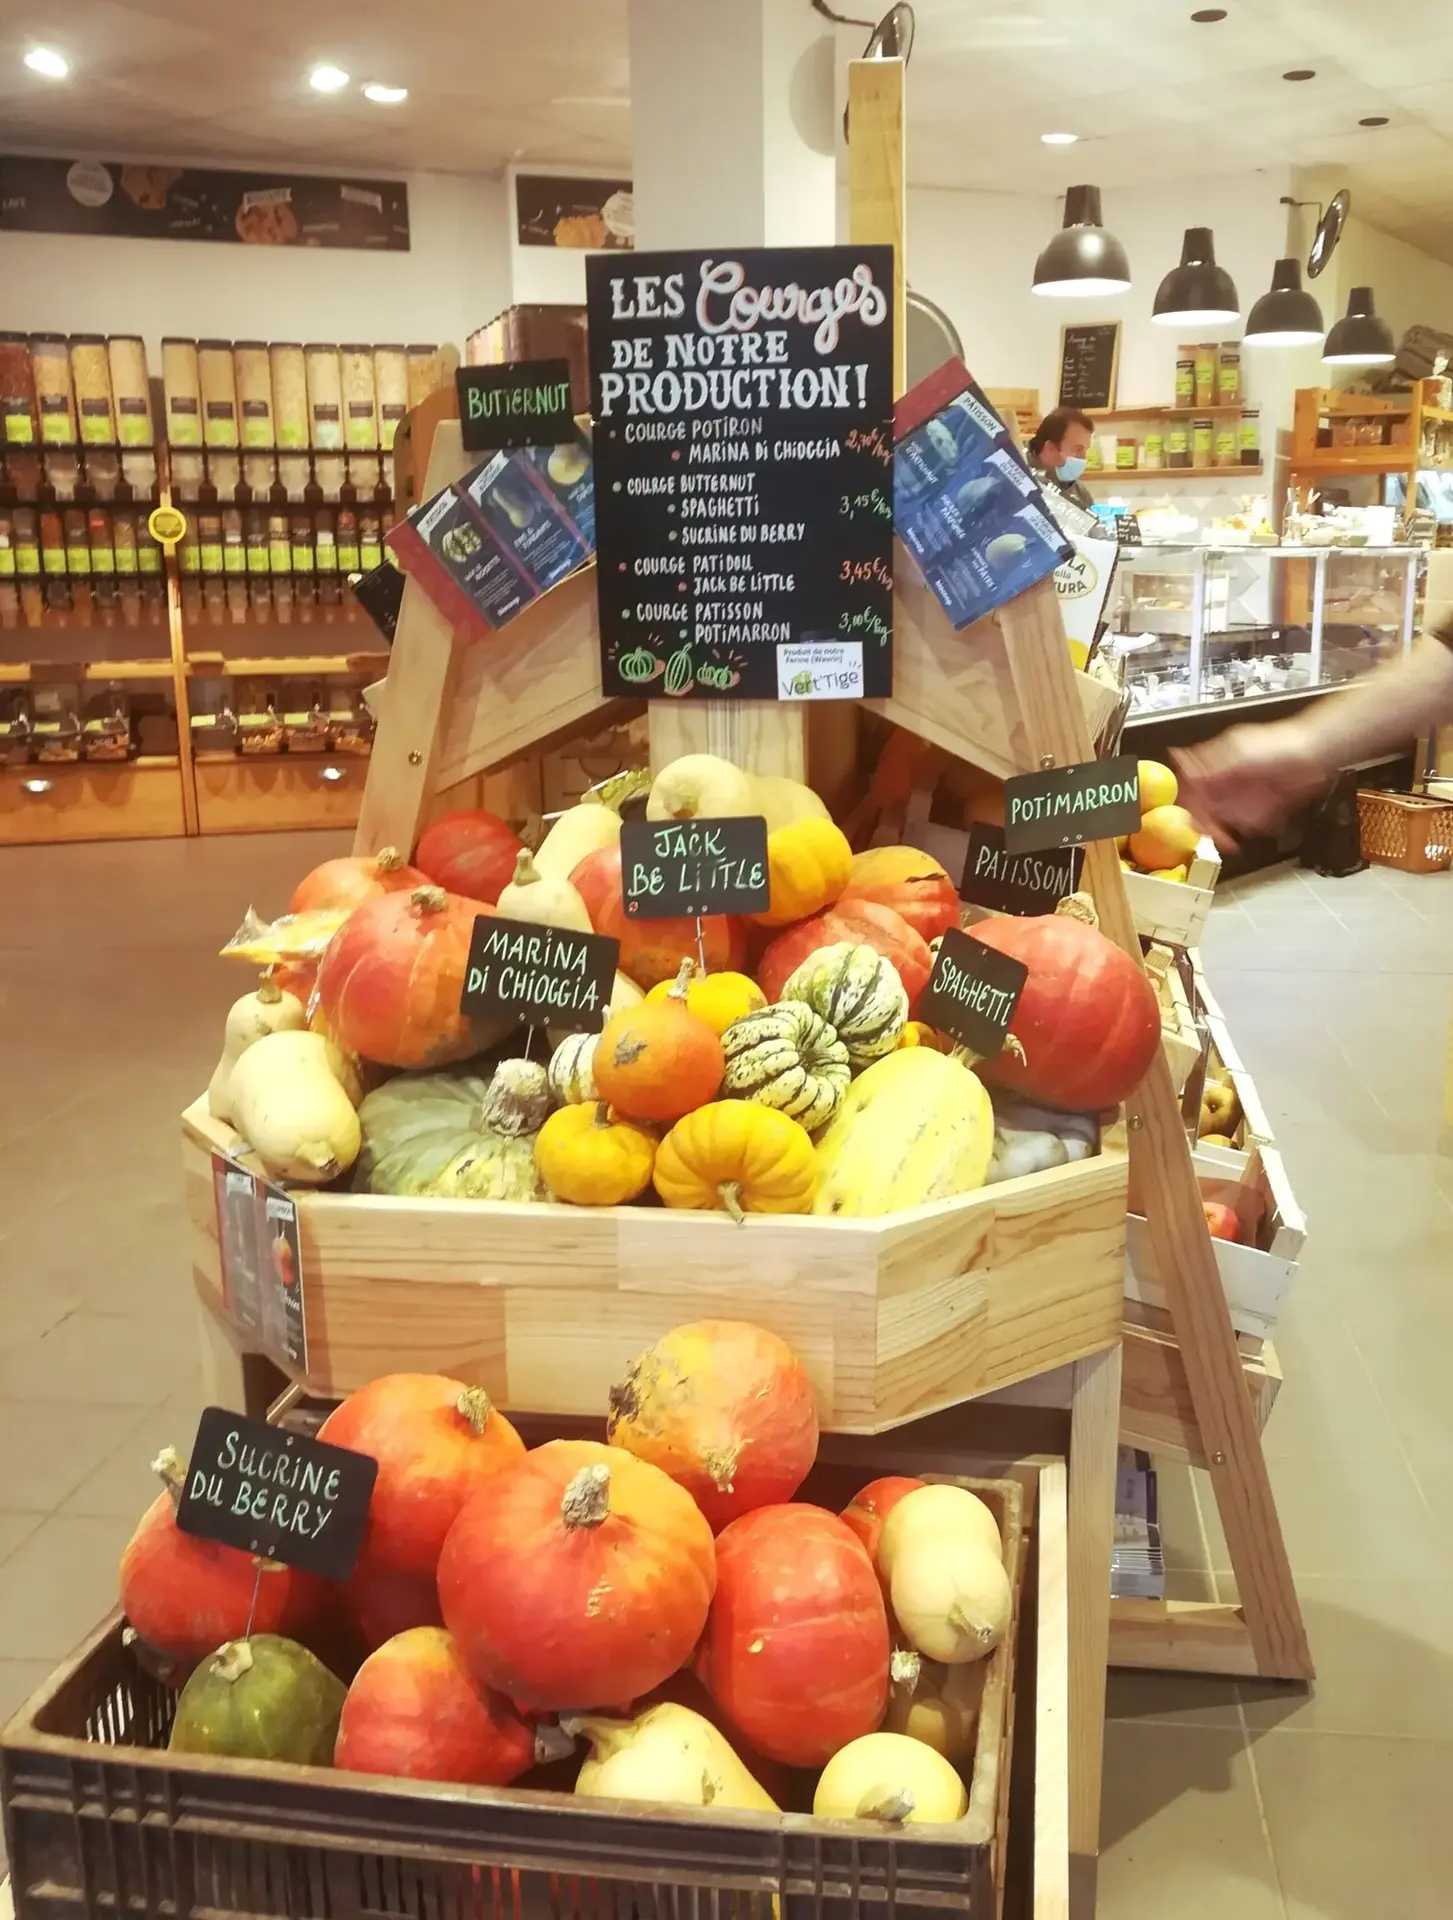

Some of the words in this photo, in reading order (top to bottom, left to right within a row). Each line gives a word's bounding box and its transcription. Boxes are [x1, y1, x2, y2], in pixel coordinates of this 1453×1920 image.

[610, 273, 685, 320] LES
[696, 259, 887, 355] Courges
[611, 337, 653, 369] DE
[665, 330, 788, 368] NOTRE
[468, 382, 569, 419] BUTTERNUT
[600, 364, 869, 417] PRODUCTION!
[625, 421, 686, 443] COURGE
[627, 476, 675, 495] COURGE
[680, 472, 756, 494] BUTTERNUT
[740, 525, 757, 543] DU
[760, 522, 806, 543] BERRY
[634, 556, 685, 576] COURGE
[693, 575, 727, 596] JACK
[729, 575, 746, 593] BE
[636, 602, 689, 622] COURGE
[654, 825, 726, 858] JACK
[628, 863, 665, 896] BE
[190, 1470, 223, 1506] DU
[230, 1481, 332, 1539] BERRY
